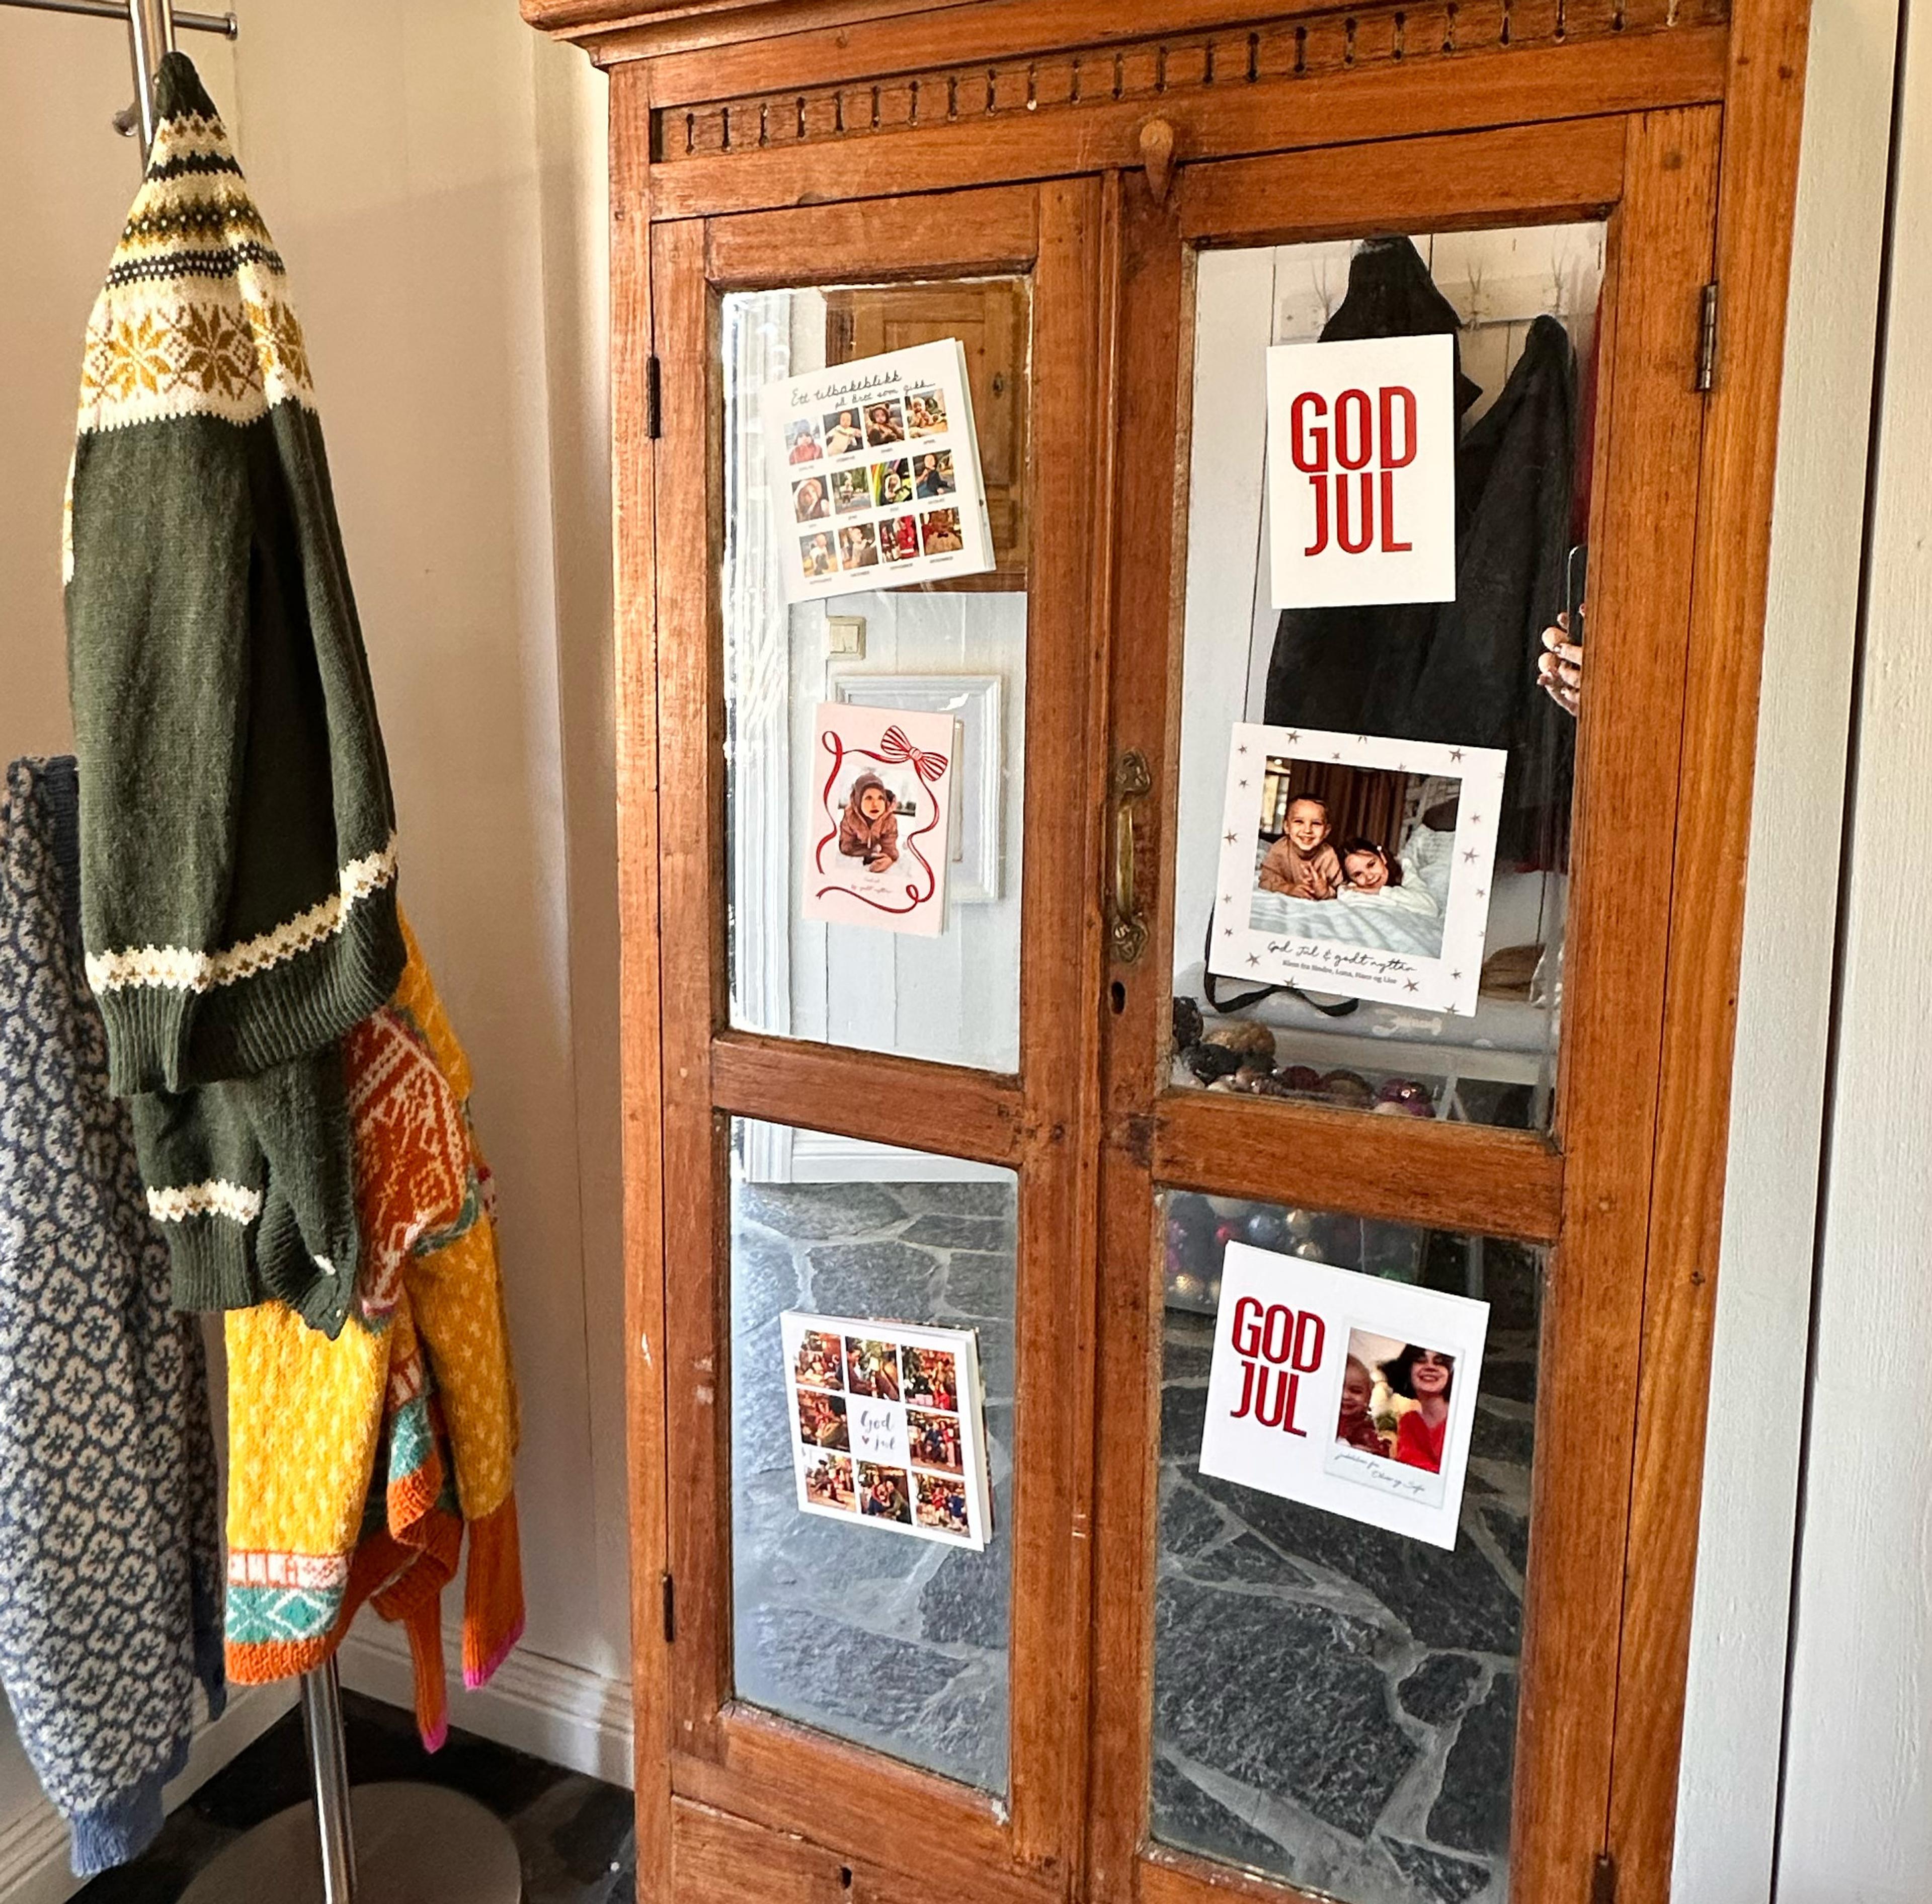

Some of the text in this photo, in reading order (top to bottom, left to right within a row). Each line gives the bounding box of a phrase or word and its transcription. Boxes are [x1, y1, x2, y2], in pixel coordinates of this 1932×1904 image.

[791, 370, 902, 407] Ett tilbakeblikk
[1291, 386, 1417, 473] GOD
[1305, 470, 1412, 557] JUL
[1231, 1295, 1325, 1373] GOD
[860, 1410, 893, 1434] God
[1230, 1360, 1307, 1438] JUL
